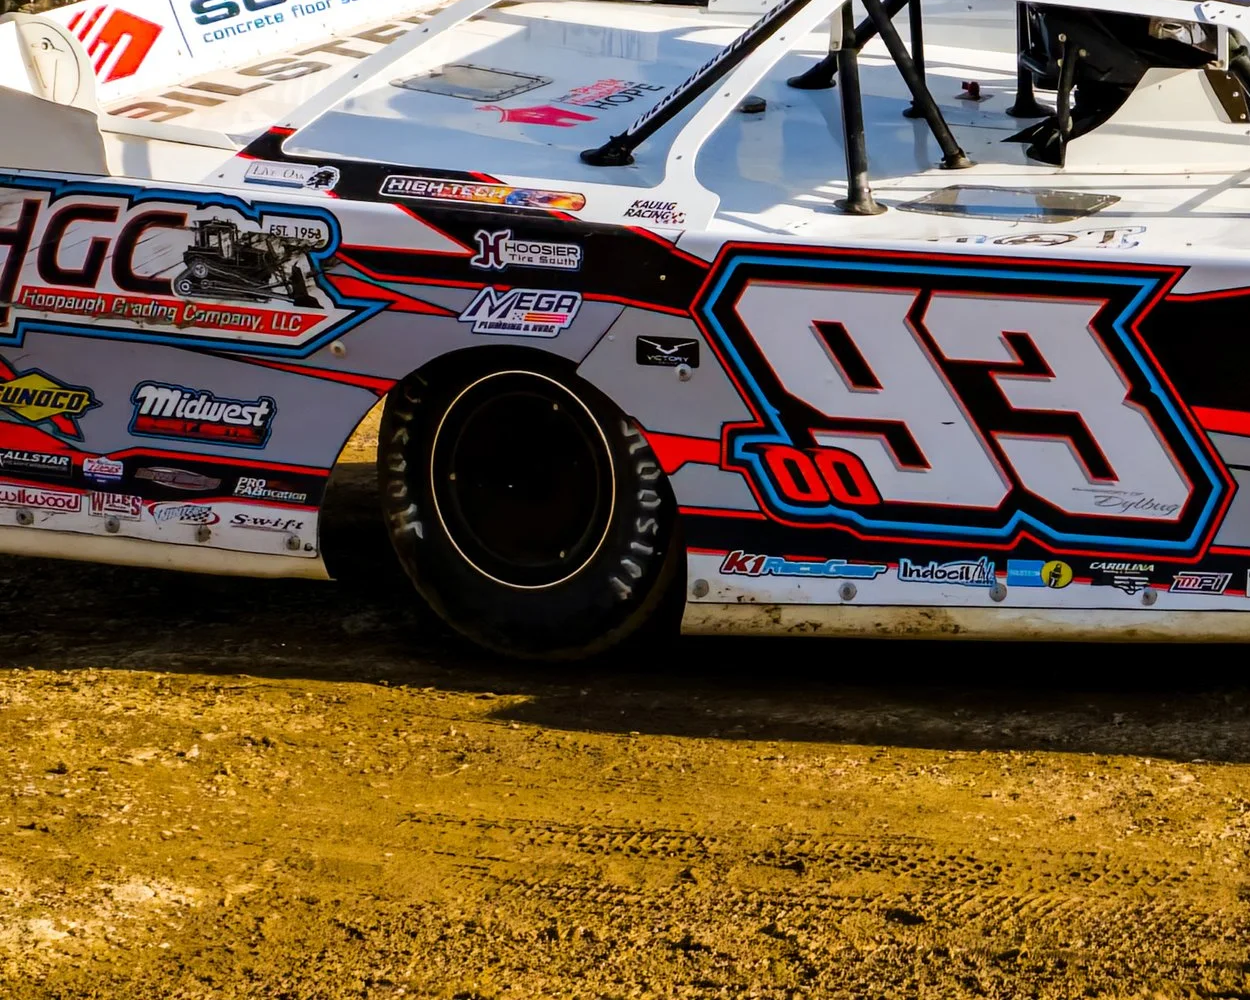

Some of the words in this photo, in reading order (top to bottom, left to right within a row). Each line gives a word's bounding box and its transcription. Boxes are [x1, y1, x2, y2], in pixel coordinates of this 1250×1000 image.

[203, 13, 284, 44] concrete
[580, 83, 665, 111] HOPE
[388, 178, 506, 198] HIGH-TECH
[623, 208, 672, 220] RACING
[630, 199, 678, 211] KAULIG
[504, 242, 579, 257] HOOSIER
[509, 253, 534, 263] Tire
[539, 255, 577, 266] South
[111, 298, 177, 321] Grading
[270, 311, 303, 332] LLC
[466, 290, 579, 319] MEGA
[0, 386, 86, 411] UNOCO
[135, 385, 272, 428] Midwest
[734, 279, 1195, 521] 93
[4, 450, 70, 466] ALLSTAR
[236, 476, 266, 488] PRO
[763, 445, 884, 505] 00
[1089, 561, 1155, 572] CAROLINA
